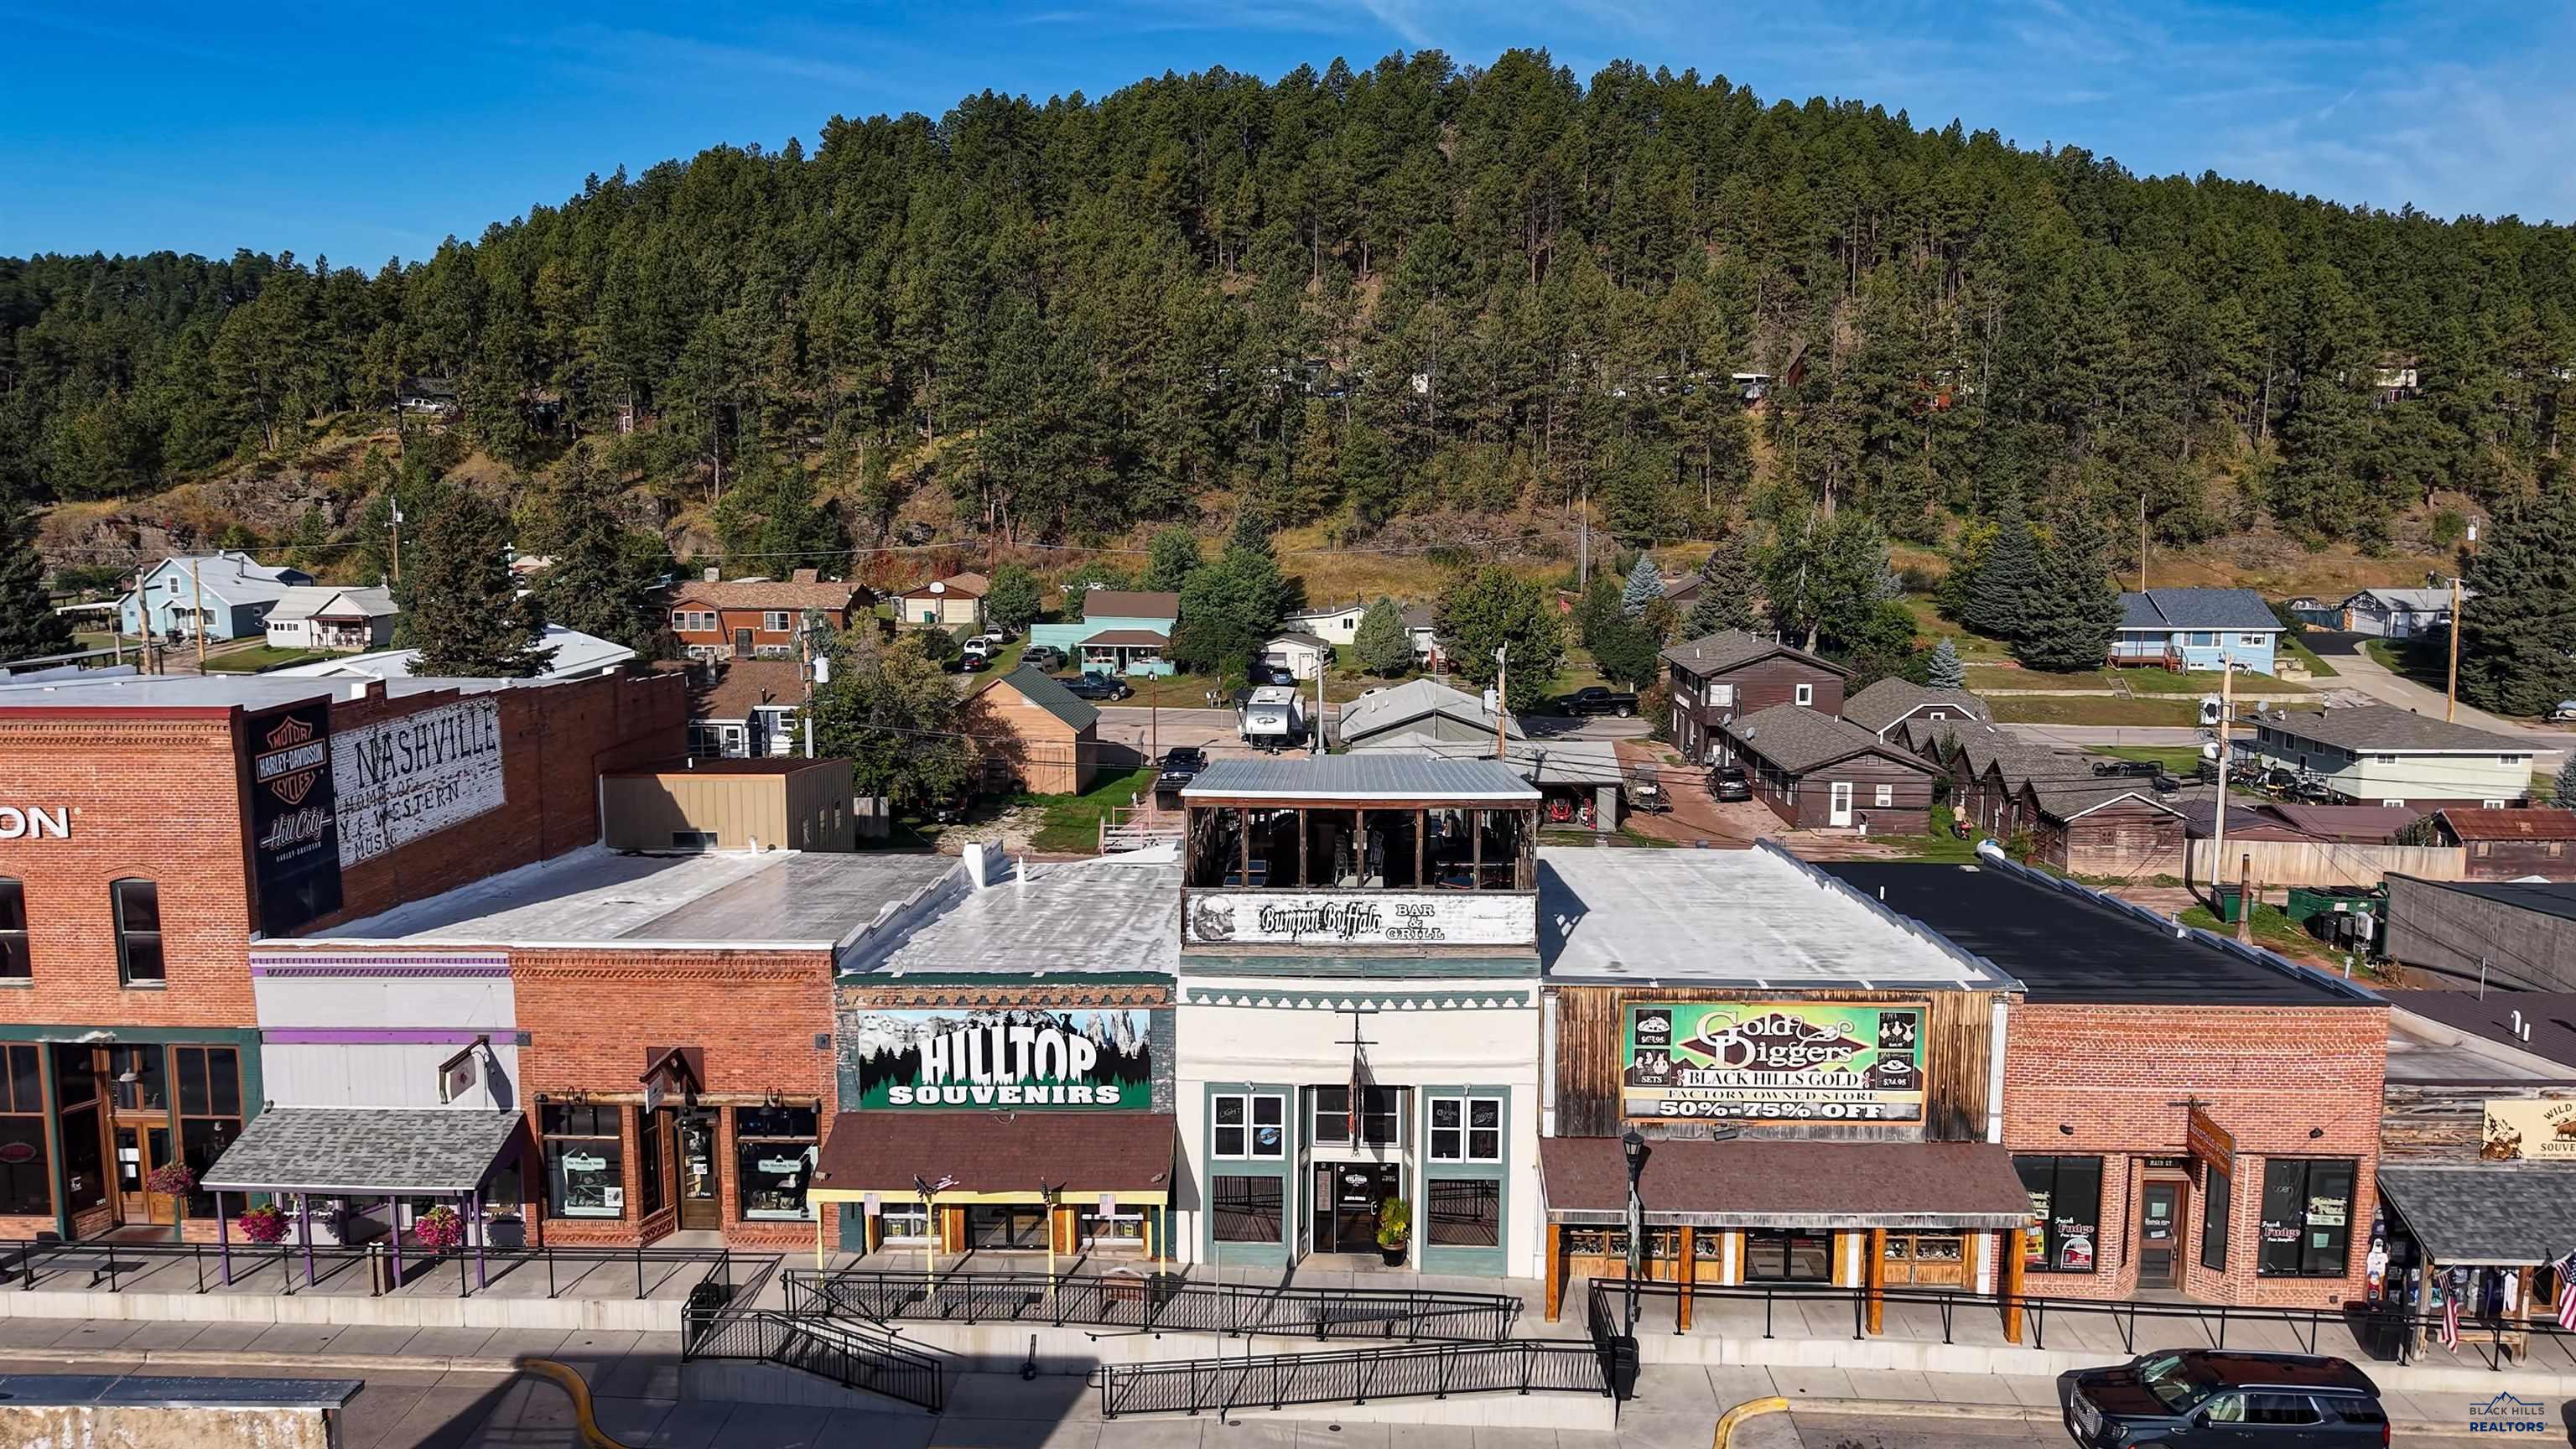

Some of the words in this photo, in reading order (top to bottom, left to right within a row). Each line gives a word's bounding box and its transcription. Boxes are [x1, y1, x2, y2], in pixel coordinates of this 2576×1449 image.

[273, 722, 309, 747] MOTOR
[355, 706, 496, 788] NASHVILLE
[258, 742, 323, 778] HARLEY-DAVIDSON
[277, 772, 310, 800] CYCLES
[374, 780, 460, 826] WESTERN
[261, 814, 295, 849] Hill
[295, 809, 333, 839] City
[355, 828, 397, 861] MUSIC
[1260, 906, 1320, 937] Bumpin
[1323, 902, 1382, 938] Buffalo
[1395, 904, 1435, 917] BAR
[1408, 917, 1422, 927] &
[1386, 927, 1445, 940] GRILL
[1695, 1010, 1800, 1047] Gold
[922, 1026, 1097, 1086] HILLTOP
[1711, 1034, 1852, 1070] Diggers
[1689, 1071, 1748, 1087] BLACK
[1753, 1072, 1805, 1087] HILLS
[1808, 1072, 1859, 1088] GOLD
[888, 1085, 1120, 1105] SOUVENIRS
[1668, 1090, 1748, 1100] FACTORY
[1753, 1090, 1815, 1100] OWNED
[1822, 1091, 1879, 1101] STORE
[1659, 1101, 1812, 1118] 50%-75%
[1820, 1103, 1886, 1119] OFF
[2543, 1104, 2573, 1120] WILD
[2541, 1143, 2576, 1151] SOUVE
[2058, 1223, 2095, 1234] Fudge
[2264, 1227, 2301, 1239] Fudge
